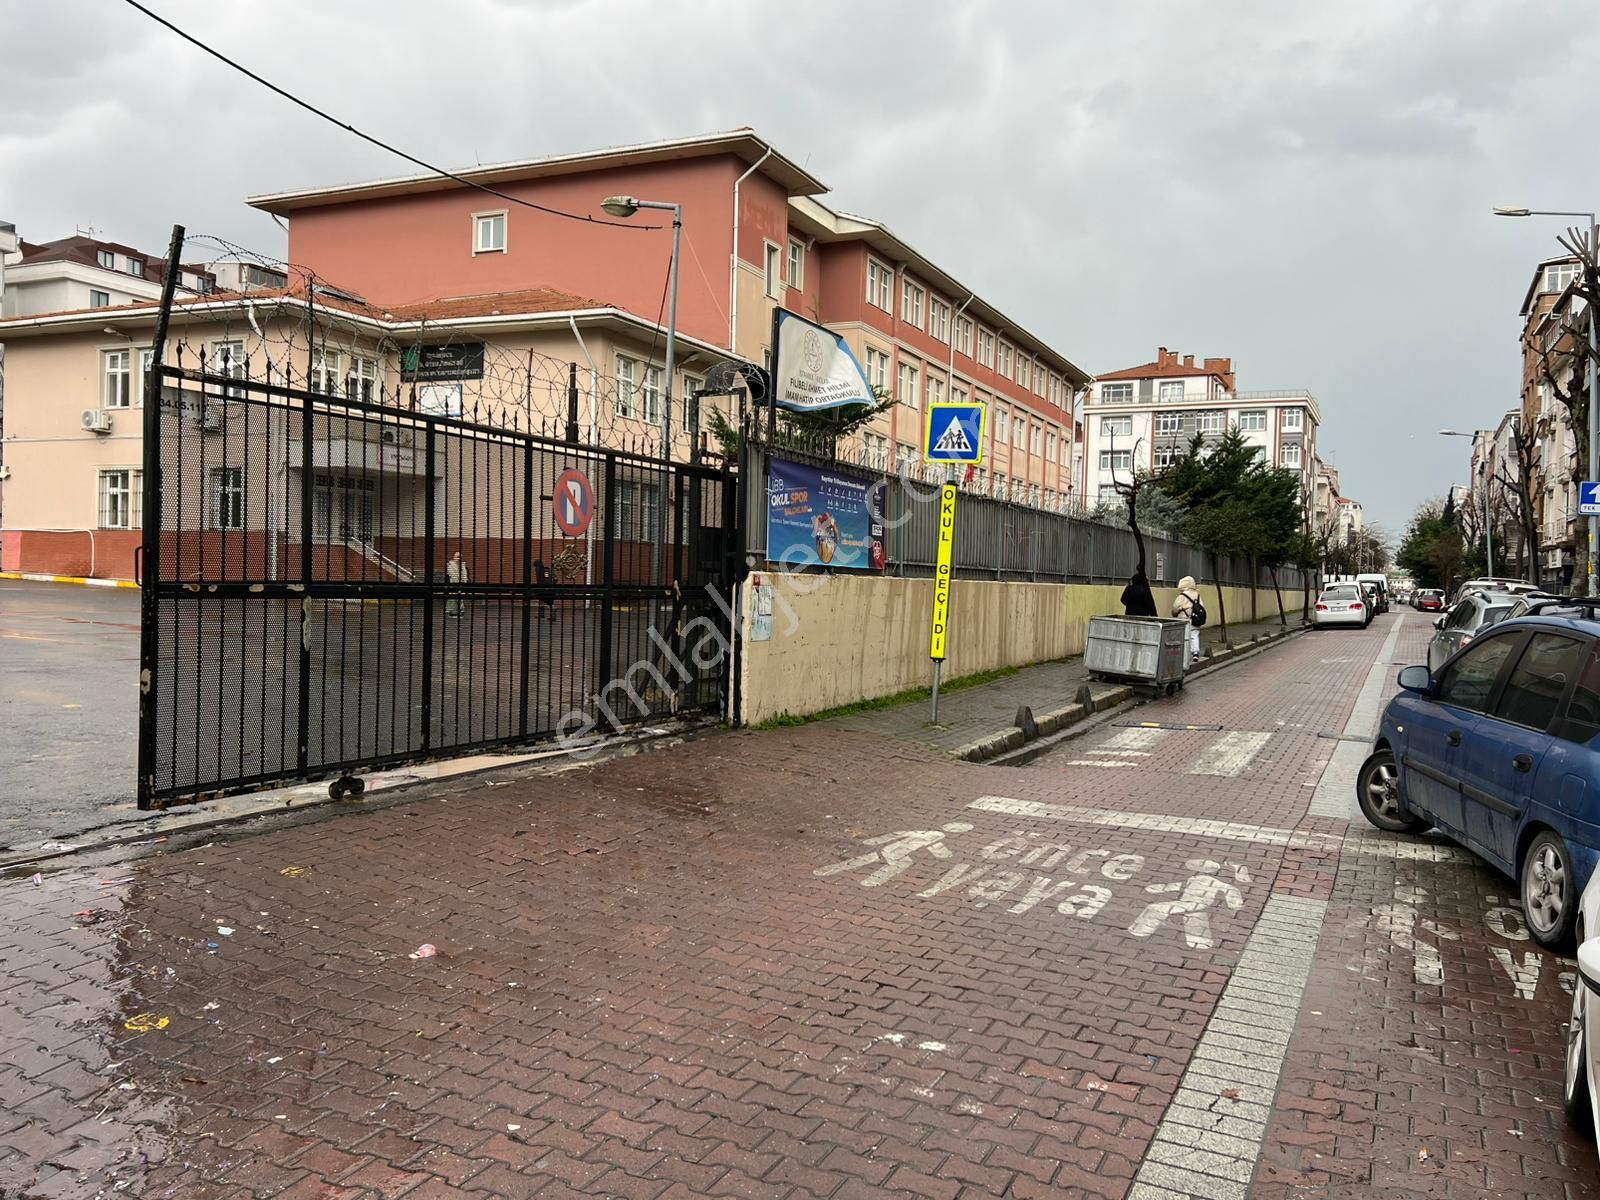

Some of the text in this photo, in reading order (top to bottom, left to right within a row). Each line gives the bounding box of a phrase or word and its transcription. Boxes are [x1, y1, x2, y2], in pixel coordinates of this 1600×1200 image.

[815, 389, 861, 404] ORTAOKULU
[771, 493, 790, 507] OKUL
[790, 490, 808, 504] SPOR
[934, 489, 954, 651] OKUL GEÇİDİ
